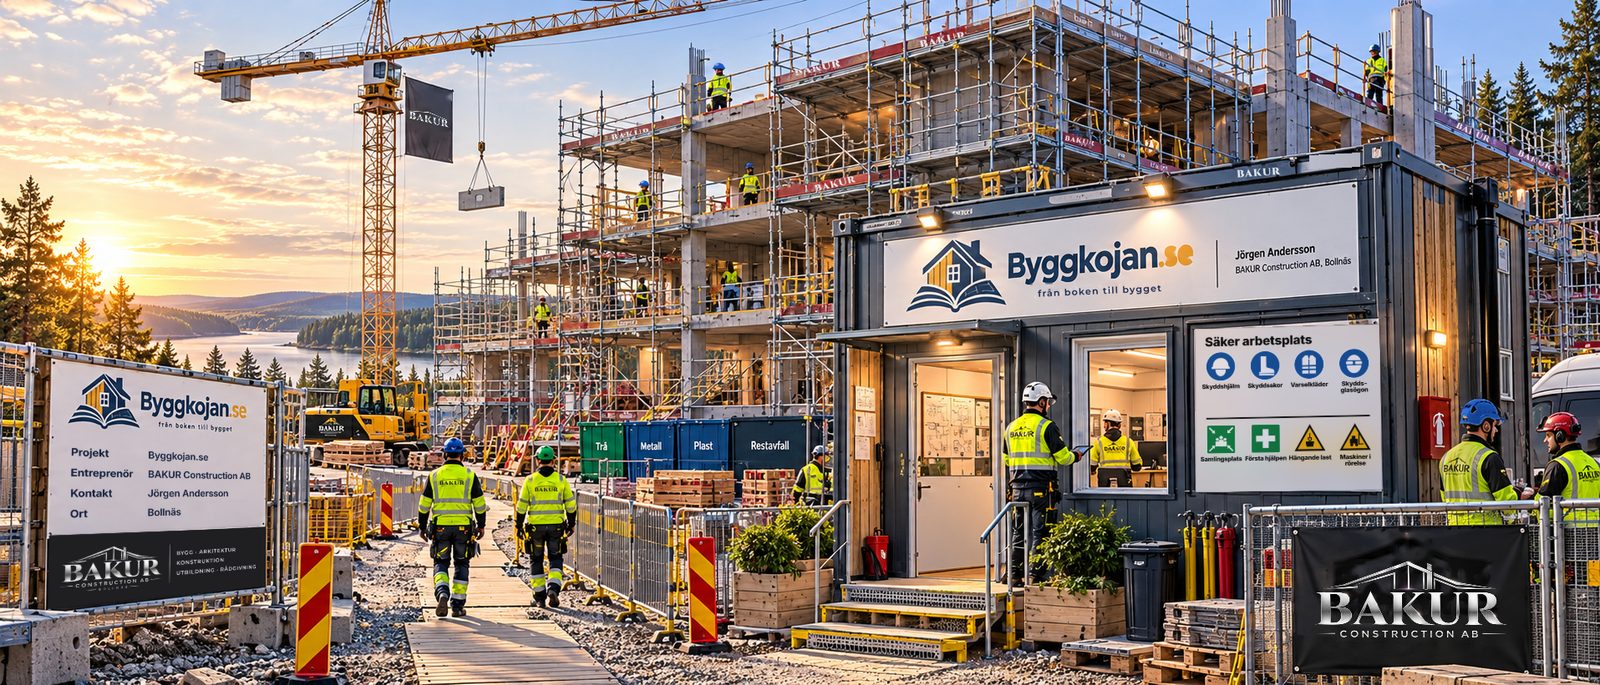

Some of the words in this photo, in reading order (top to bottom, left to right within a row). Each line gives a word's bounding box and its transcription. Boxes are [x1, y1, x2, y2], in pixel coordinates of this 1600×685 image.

[409, 111, 449, 128] BAKUR
[1236, 167, 1280, 178] BAKUR
[1235, 250, 1265, 261] Jörgen
[1267, 246, 1315, 257] Andersson
[1008, 241, 1194, 285] Byggkojan.se
[1235, 265, 1260, 274] BAKUR
[1262, 261, 1308, 272] Construction
[1310, 259, 1323, 268] AB,
[1325, 257, 1351, 266] Bollnäs
[1038, 288, 1060, 298] från
[1064, 287, 1098, 296] boken
[1102, 286, 1118, 295] till
[1122, 285, 1162, 295] bygget
[1205, 336, 1240, 347] Säker
[1242, 335, 1312, 347] arbetsplats
[140, 391, 247, 420] Byggkojan.se
[640, 441, 662, 450] Metall
[694, 441, 713, 450] Plast
[751, 441, 789, 450] Restavfall
[71, 448, 109, 458] Projekt
[148, 451, 208, 462] Byggkojan.se
[71, 468, 133, 479] Entreprenör
[148, 470, 181, 479] BAKUR
[183, 471, 238, 480] Construction
[70, 489, 112, 498] Kontakt
[148, 489, 180, 499] Jörgen
[182, 489, 229, 497] Andersson
[70, 509, 88, 518] Ort
[148, 508, 181, 517] Bollnäs
[176, 558, 224, 566] KONSTRUKTION
[63, 559, 162, 583] BAKUR
[75, 579, 137, 589] CONSTRUCTION
[1316, 591, 1506, 626] BAKUR
[1340, 630, 1454, 638] CONSTRUCTION
[1461, 630, 1479, 638] AB
